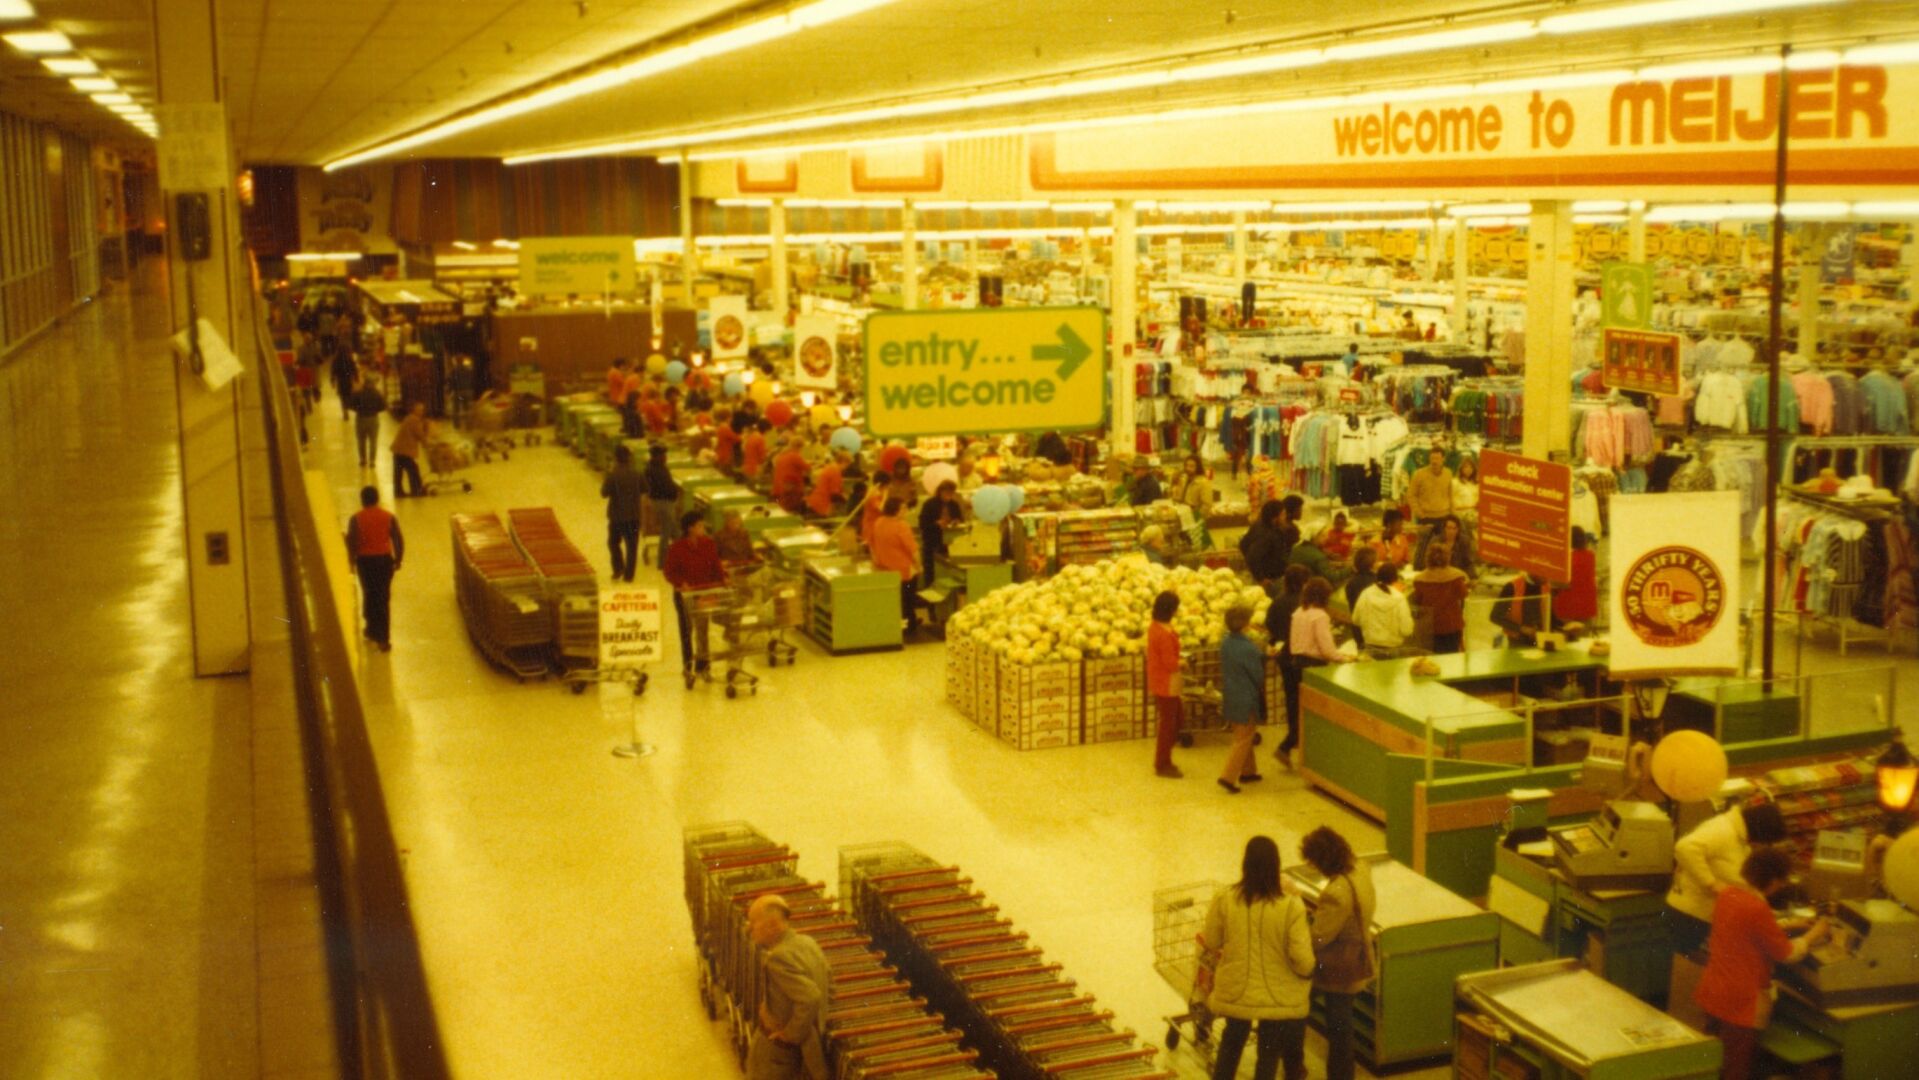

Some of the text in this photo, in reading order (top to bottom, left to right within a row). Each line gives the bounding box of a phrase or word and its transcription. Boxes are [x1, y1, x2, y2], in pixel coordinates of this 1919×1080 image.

[1333, 65, 1888, 157] welcome to MEIJER
[536, 249, 620, 265] welcome
[880, 374, 1057, 411] welcome
[1506, 461, 1540, 479] check
[1628, 552, 1690, 592] THRIFTY
[1691, 559, 1720, 613] YEARS
[602, 602, 658, 612] CAFETERIA
[602, 631, 659, 644] BREAKFAST
